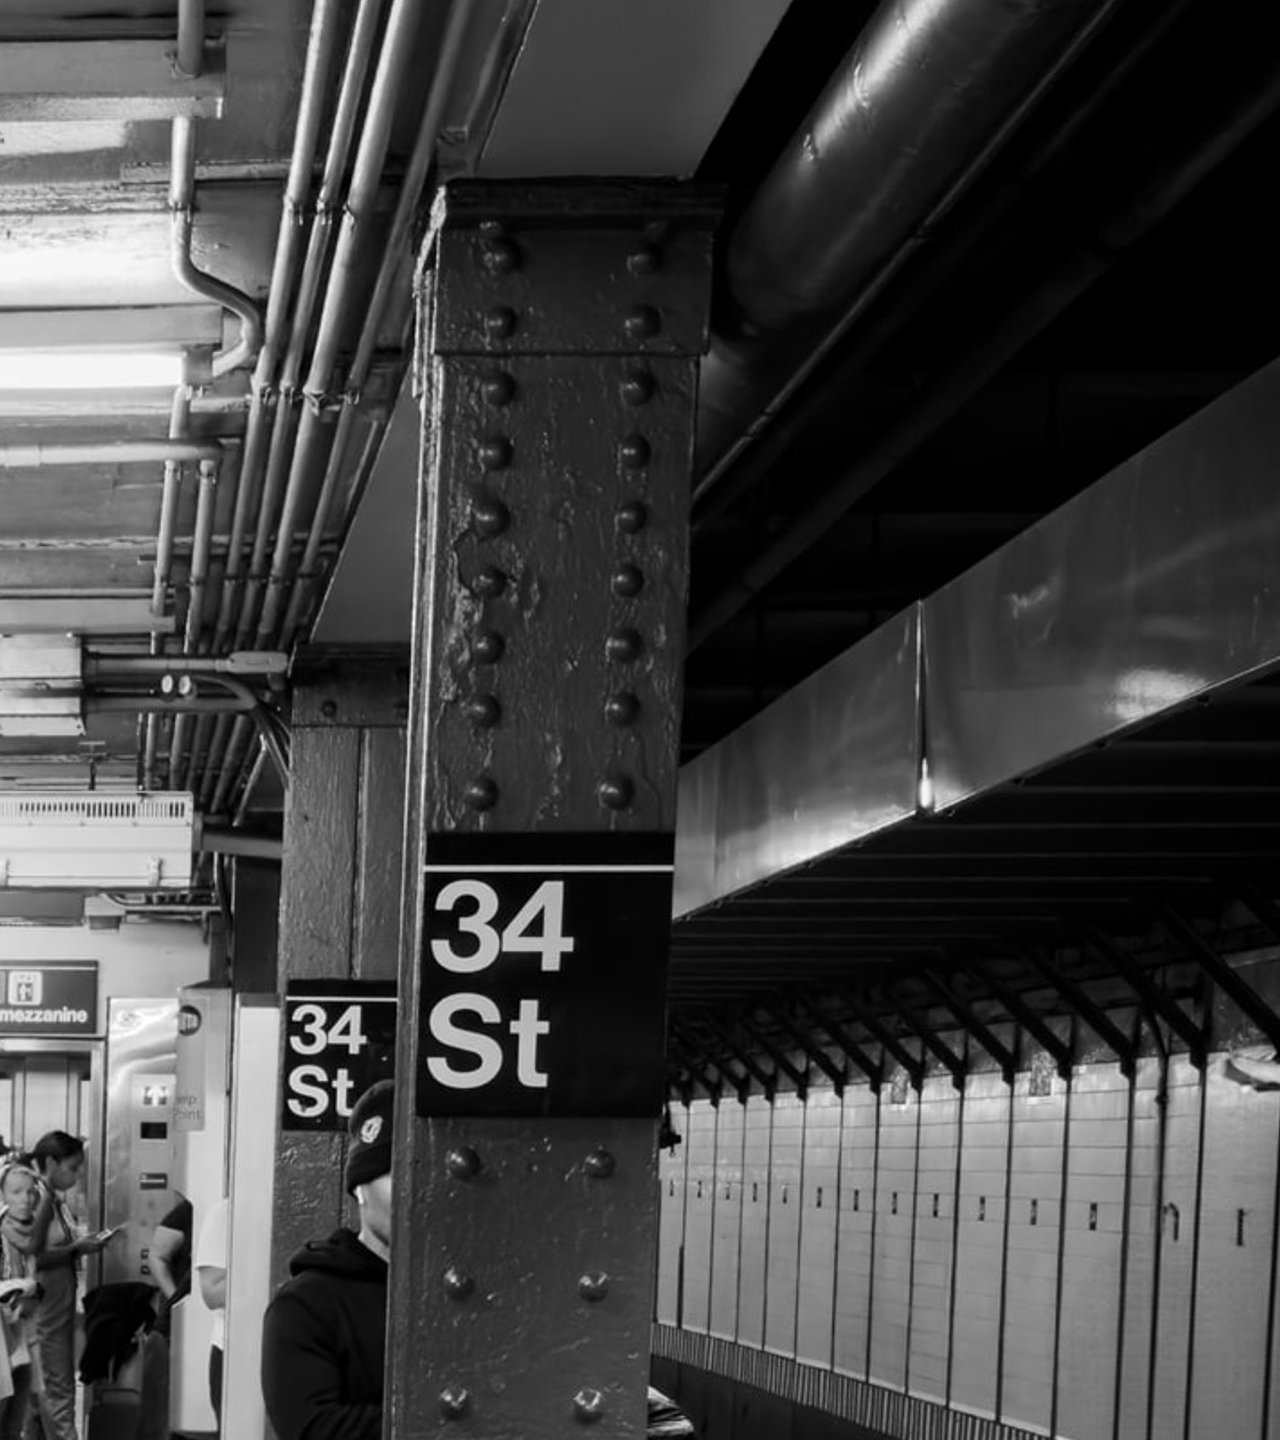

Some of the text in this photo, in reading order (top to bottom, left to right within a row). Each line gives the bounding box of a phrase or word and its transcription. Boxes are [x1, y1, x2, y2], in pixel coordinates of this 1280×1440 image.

[430, 879, 575, 973] 34
[289, 1003, 368, 1055] 34
[426, 992, 550, 1089] St
[287, 1064, 353, 1118] St
